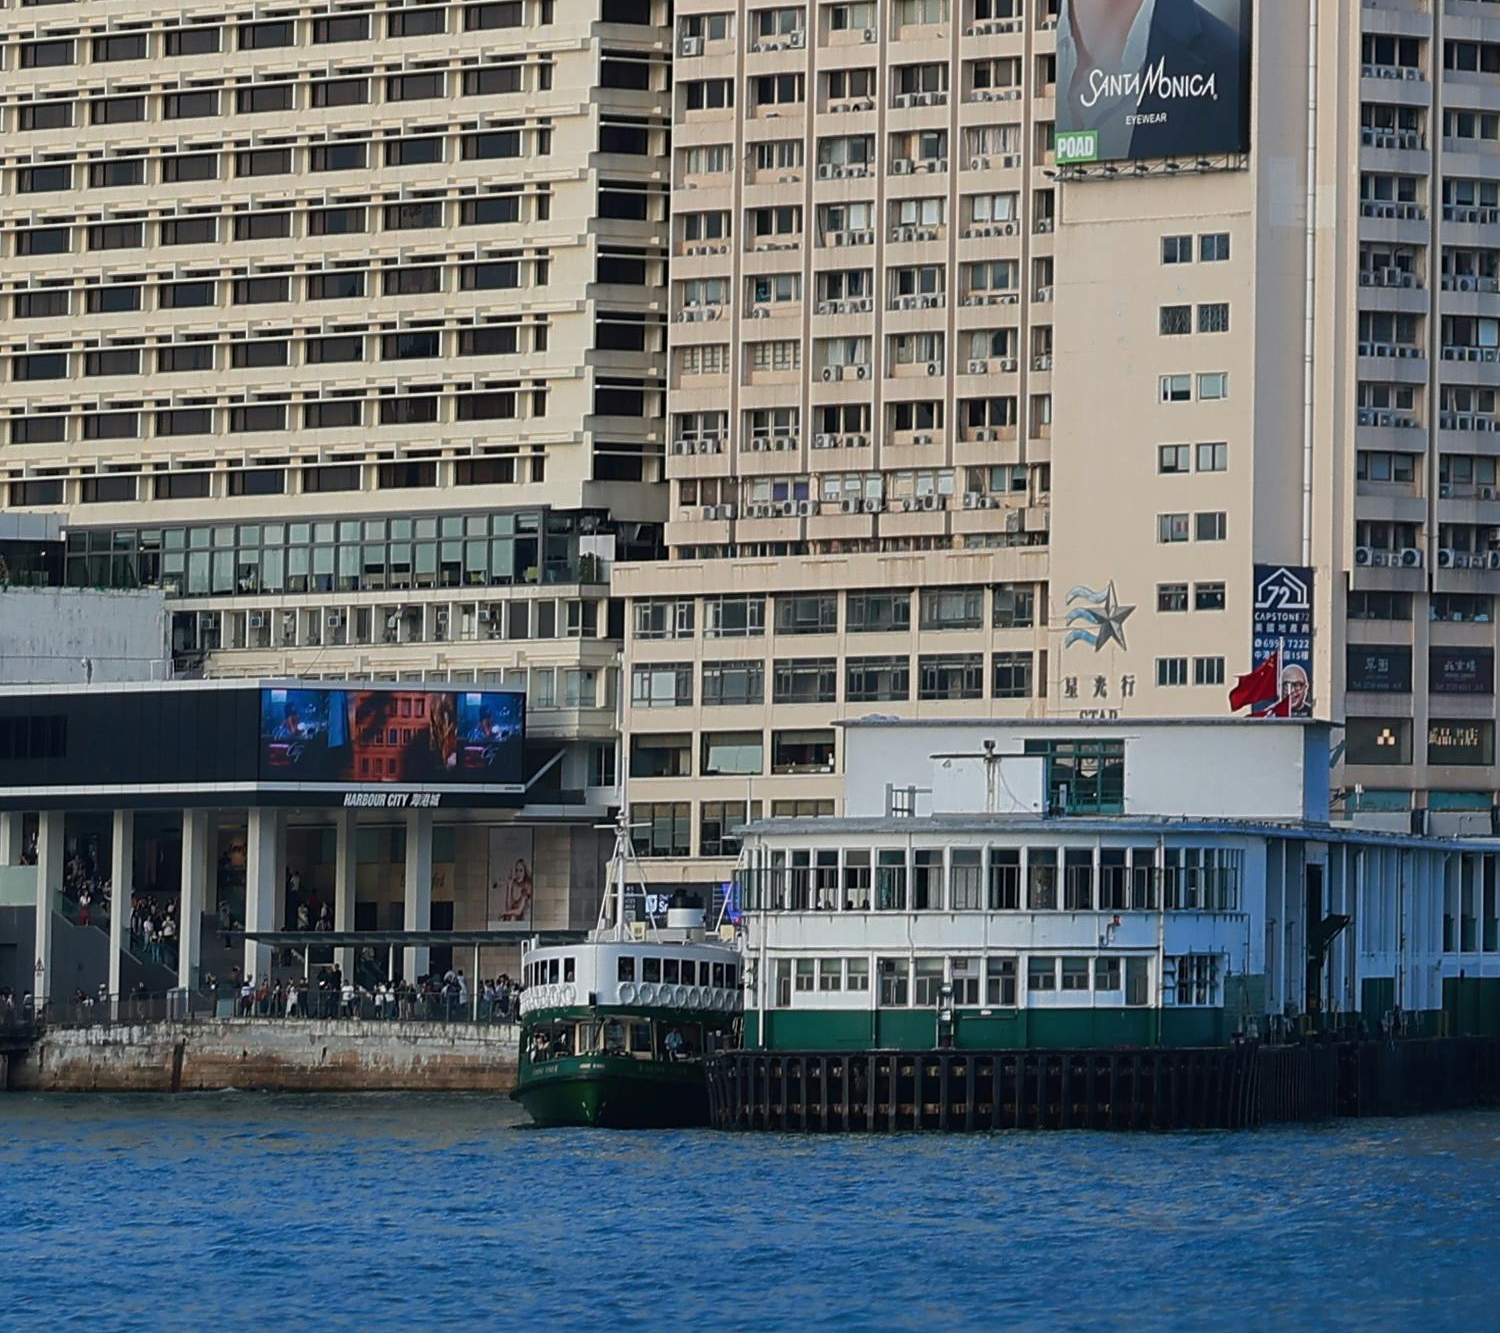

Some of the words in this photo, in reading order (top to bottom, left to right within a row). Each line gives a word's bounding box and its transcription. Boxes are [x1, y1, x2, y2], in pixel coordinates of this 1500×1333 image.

[1125, 112, 1168, 126] EYEWEAR
[1056, 135, 1095, 159] POAD
[1287, 638, 1310, 649] 7222
[1063, 674, 1136, 699] 星光行
[343, 793, 387, 808] HARBOUR
[387, 793, 408, 808] CITY
